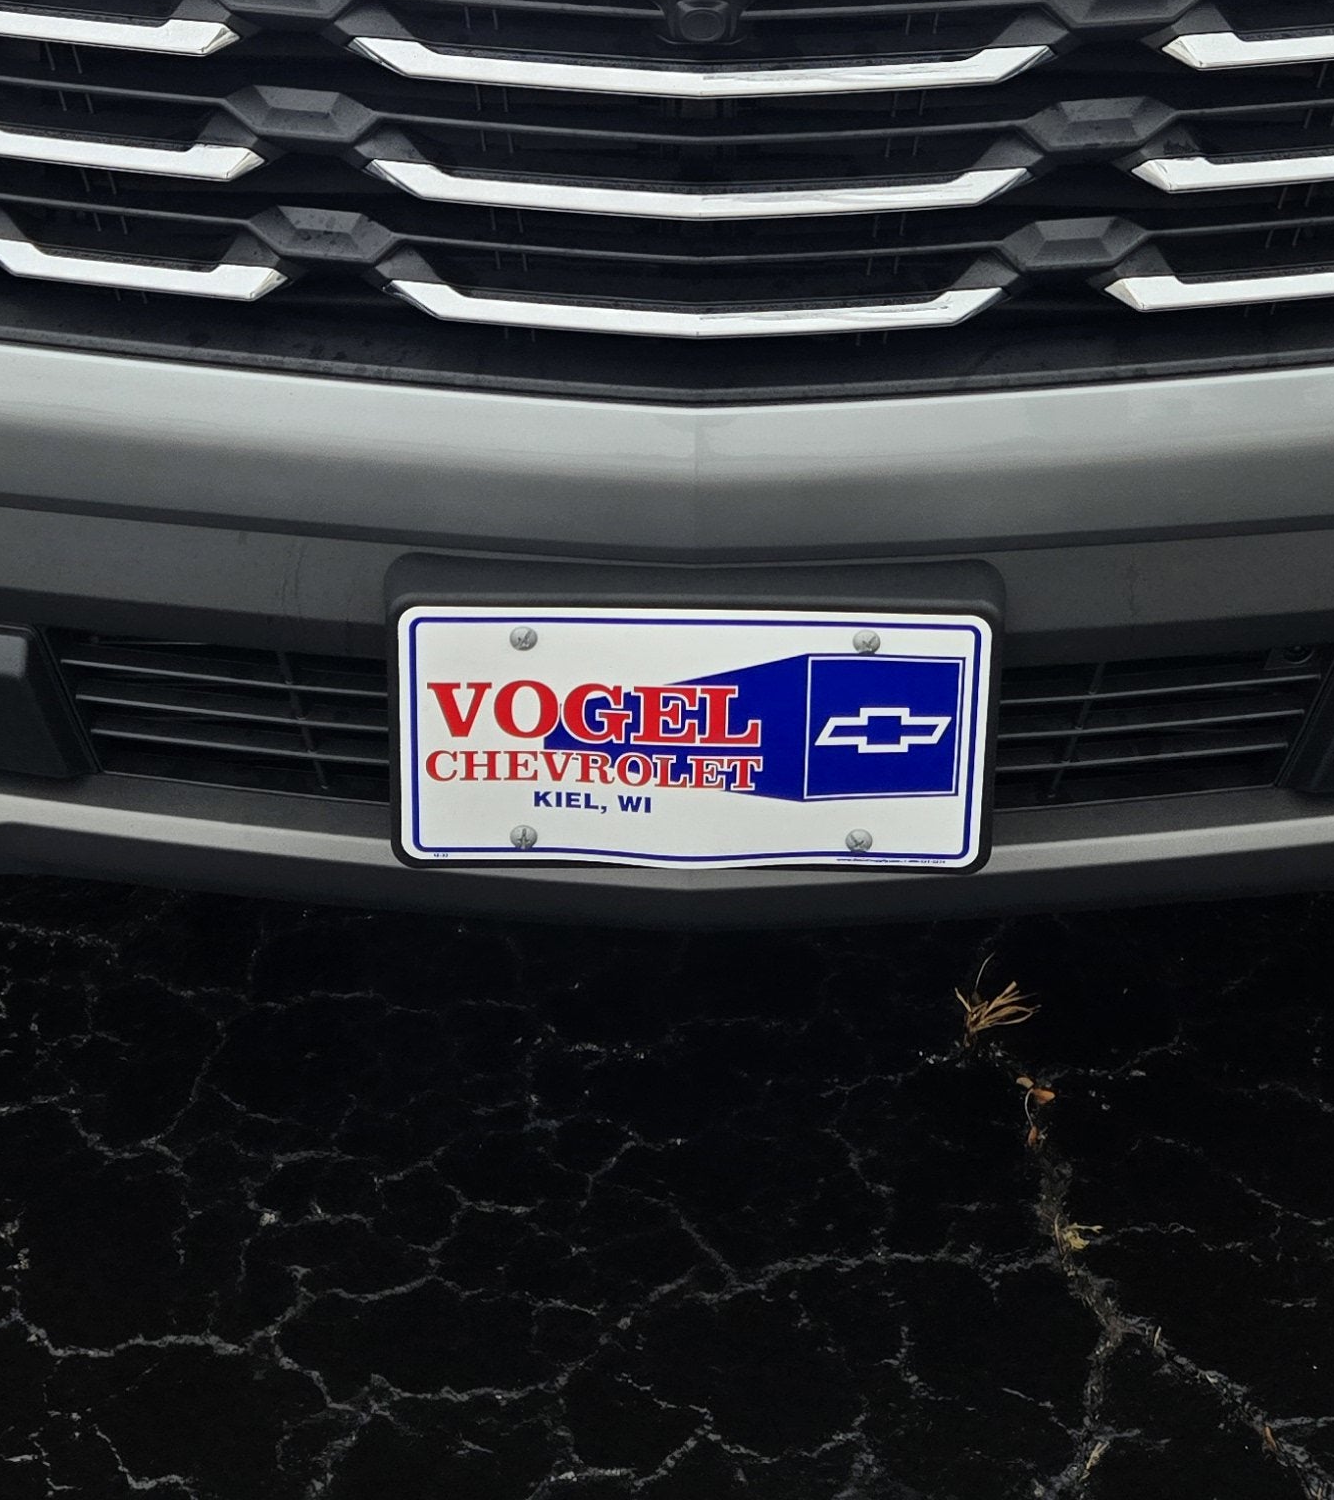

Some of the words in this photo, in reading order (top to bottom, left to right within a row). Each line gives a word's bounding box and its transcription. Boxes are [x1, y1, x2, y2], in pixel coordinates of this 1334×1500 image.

[427, 679, 762, 746] VOGEL
[425, 750, 762, 790] CHEVROLET
[533, 791, 607, 814] KIEL,
[617, 794, 652, 814] WI
